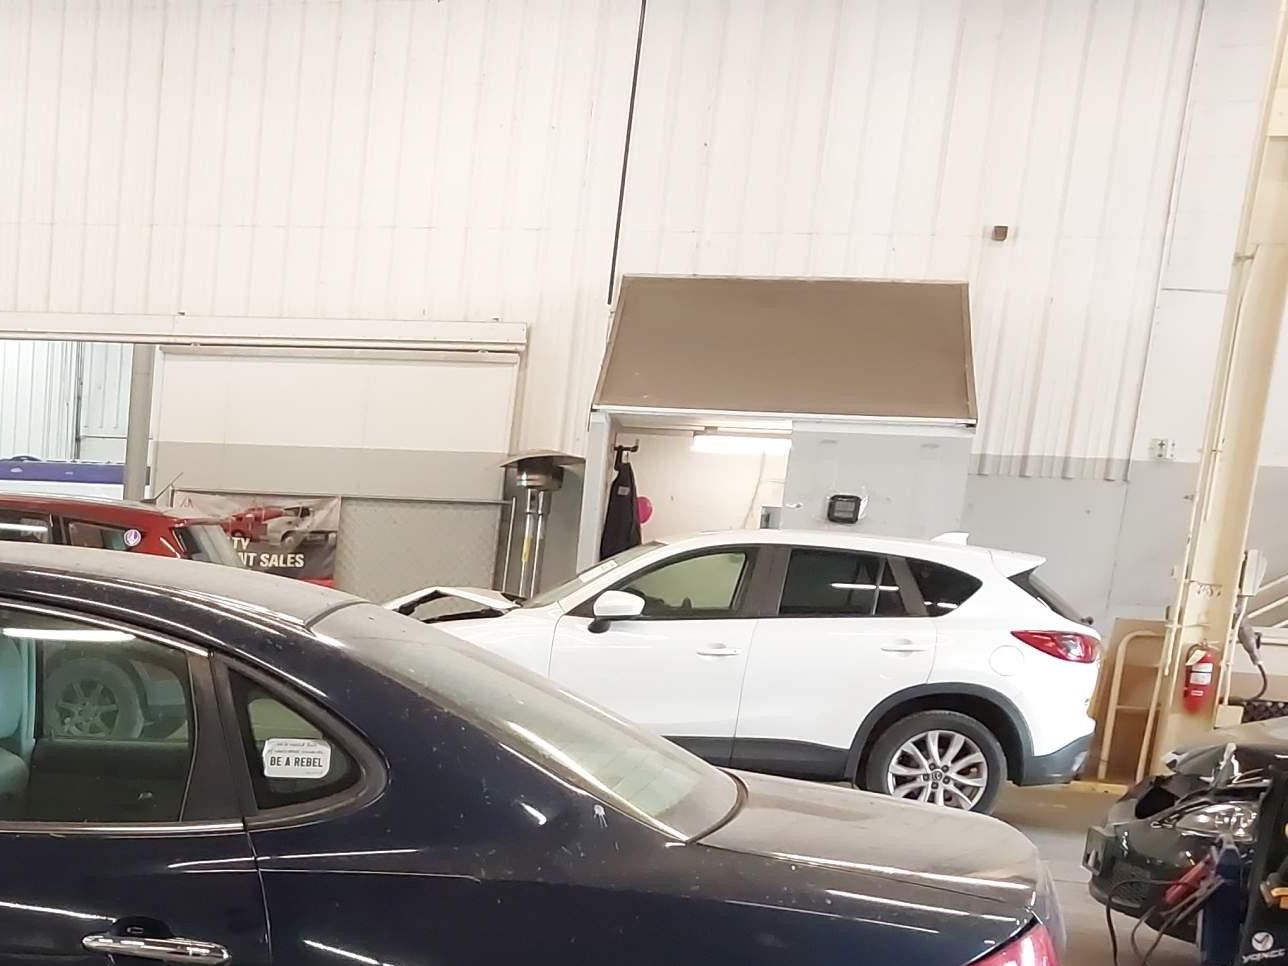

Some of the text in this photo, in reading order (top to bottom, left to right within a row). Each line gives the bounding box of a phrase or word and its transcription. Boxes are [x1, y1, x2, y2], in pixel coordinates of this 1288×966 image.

[259, 553, 305, 568] SALES
[270, 756, 323, 768] BE A REBEL
